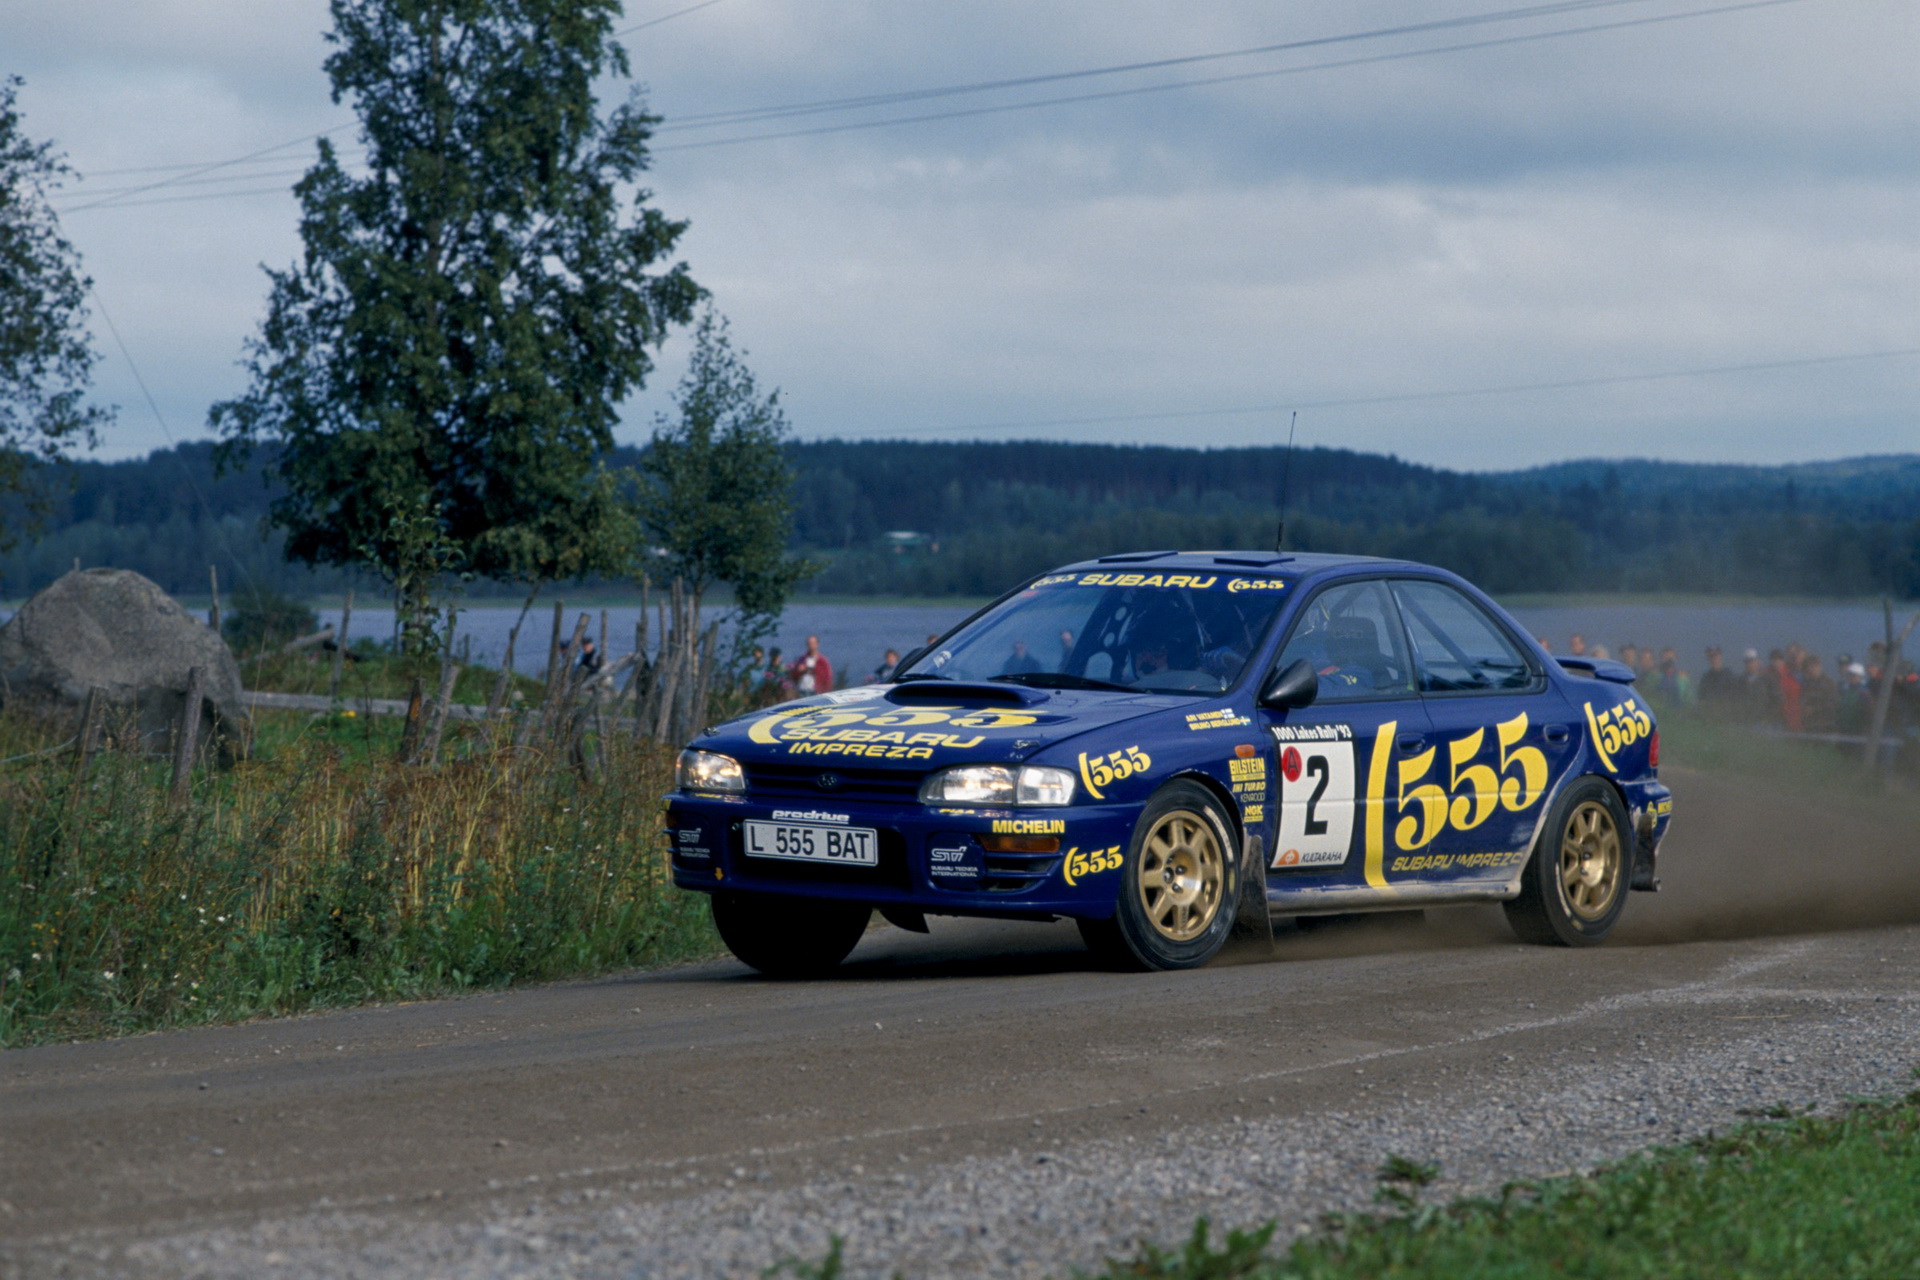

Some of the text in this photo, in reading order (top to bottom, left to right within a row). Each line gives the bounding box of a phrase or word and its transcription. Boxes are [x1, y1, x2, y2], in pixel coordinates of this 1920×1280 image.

[1078, 573, 1217, 589] SUBARU
[1233, 579, 1285, 591] 555
[1271, 726, 1295, 740] 1000
[1292, 725, 1319, 740] Lakes
[1315, 724, 1339, 741] Rally
[1597, 698, 1651, 754] 555
[779, 727, 986, 749] SUBARU
[788, 742, 934, 759] IMPREZA
[1089, 746, 1151, 786] 555
[1229, 757, 1265, 775] BILSTEIN
[1395, 711, 1548, 850] 555
[1304, 755, 1329, 836] 2
[772, 809, 850, 824] prodrive
[1244, 804, 1263, 817] NGK
[992, 819, 1065, 834] MICHELIN
[750, 825, 870, 860] L 555 BAT
[1072, 846, 1124, 877] 555
[1391, 855, 1452, 872] SUBARU
